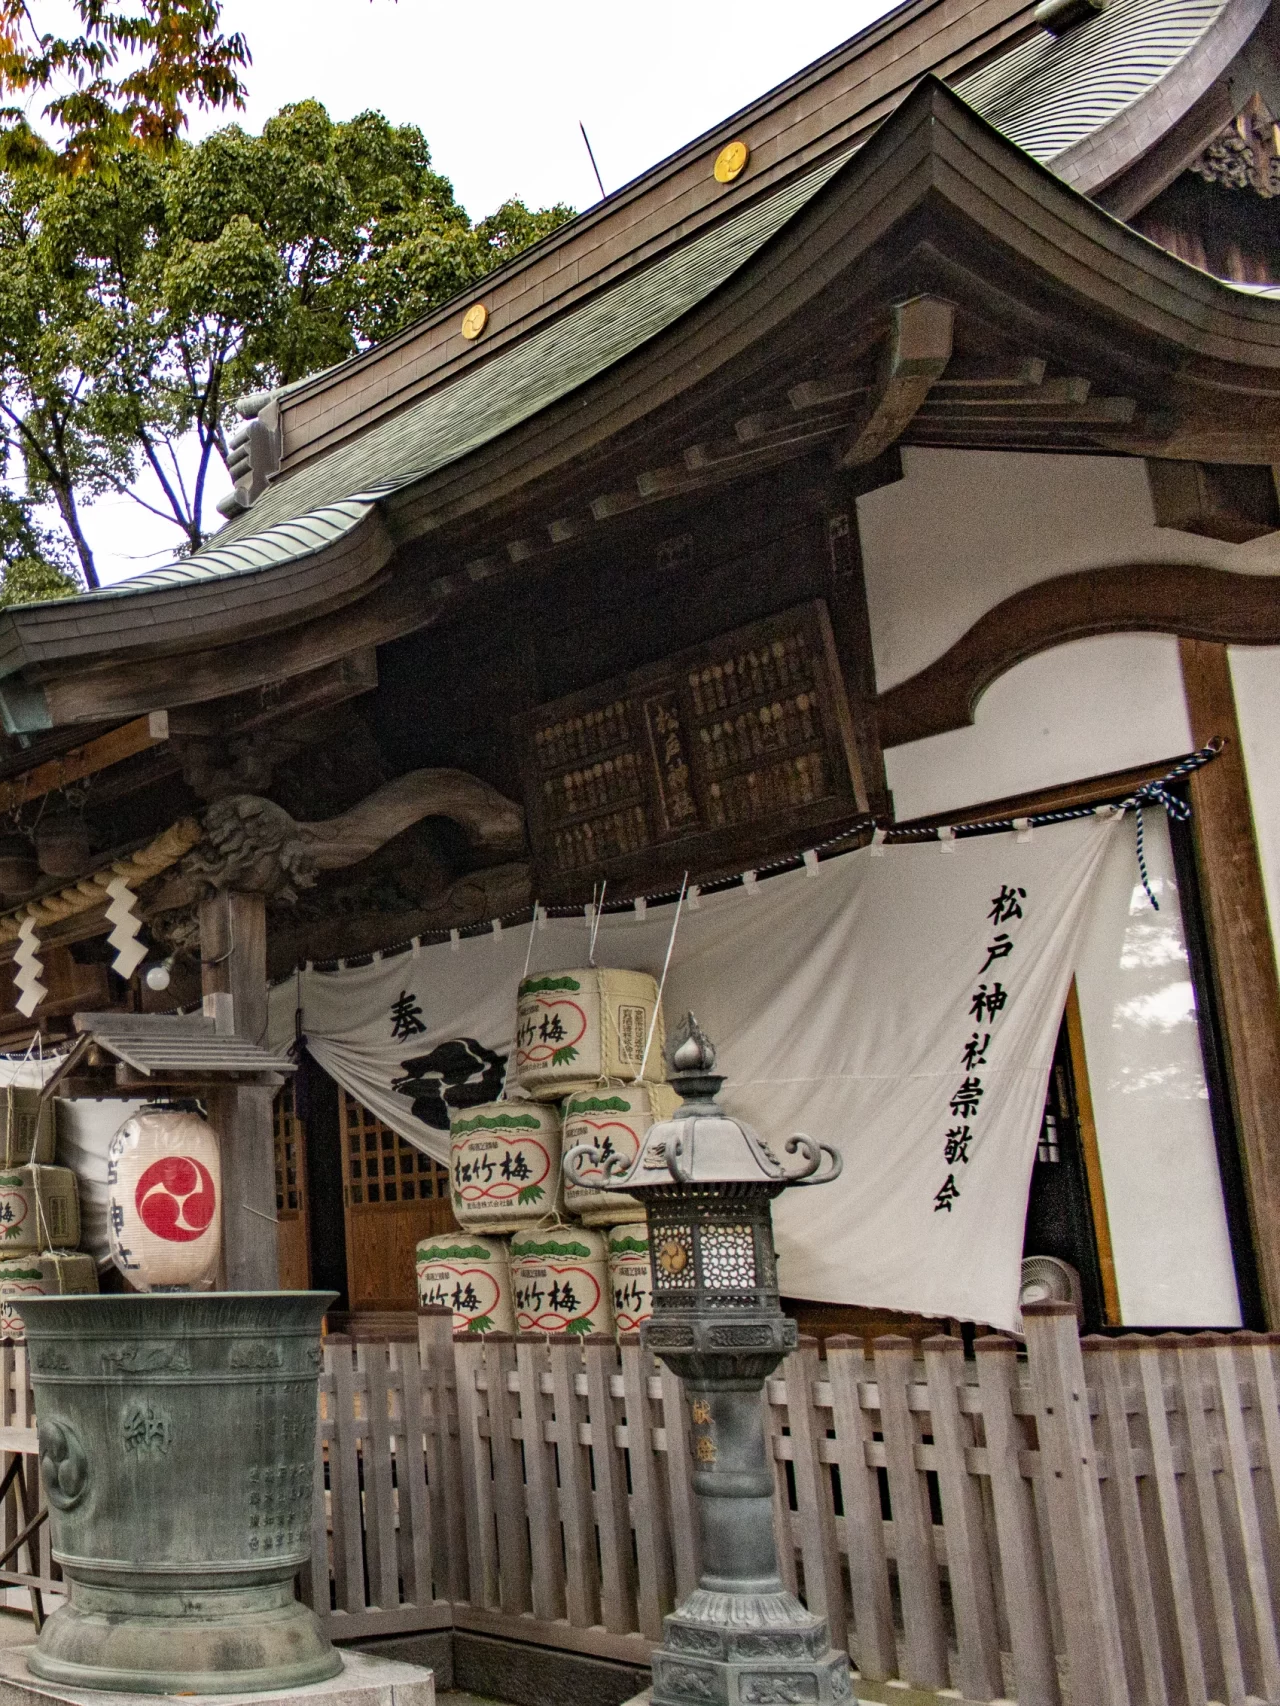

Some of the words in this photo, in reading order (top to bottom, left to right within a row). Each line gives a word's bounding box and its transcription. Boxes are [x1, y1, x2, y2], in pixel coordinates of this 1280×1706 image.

[390, 990, 427, 1044] 奉
[933, 884, 1027, 1213] 松戸神社崇敬会
[454, 1151, 533, 1187] 松竹梅
